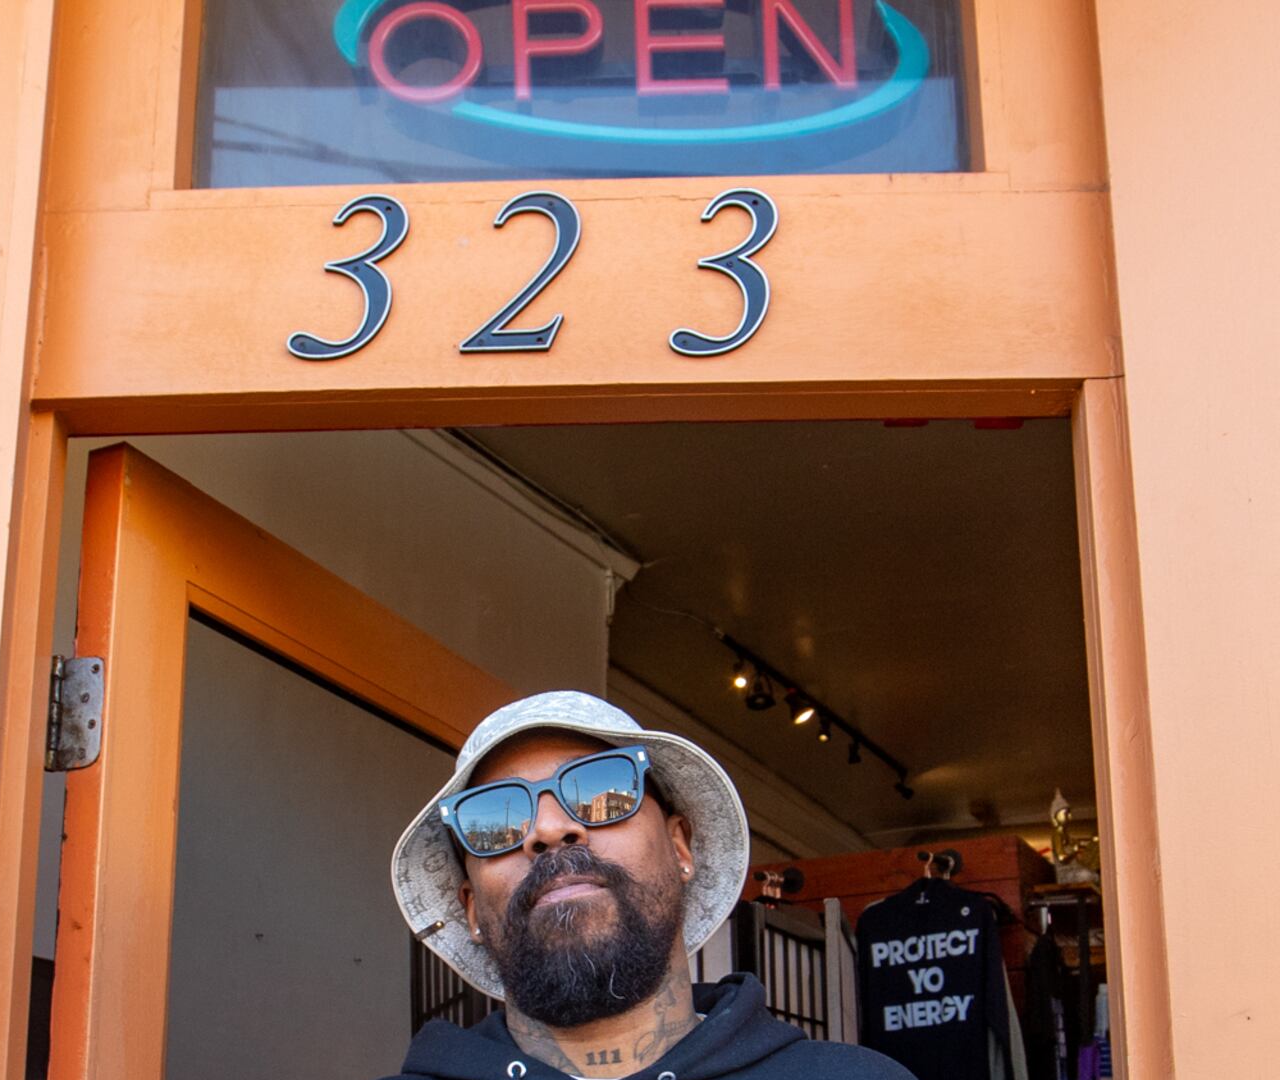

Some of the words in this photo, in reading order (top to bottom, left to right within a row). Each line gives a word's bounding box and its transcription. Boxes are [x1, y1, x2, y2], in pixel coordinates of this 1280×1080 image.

[368, 0, 857, 101] OPEN
[871, 928, 980, 968] PROTECT
[907, 966, 945, 995] YO
[884, 995, 972, 1031] ENERGY
